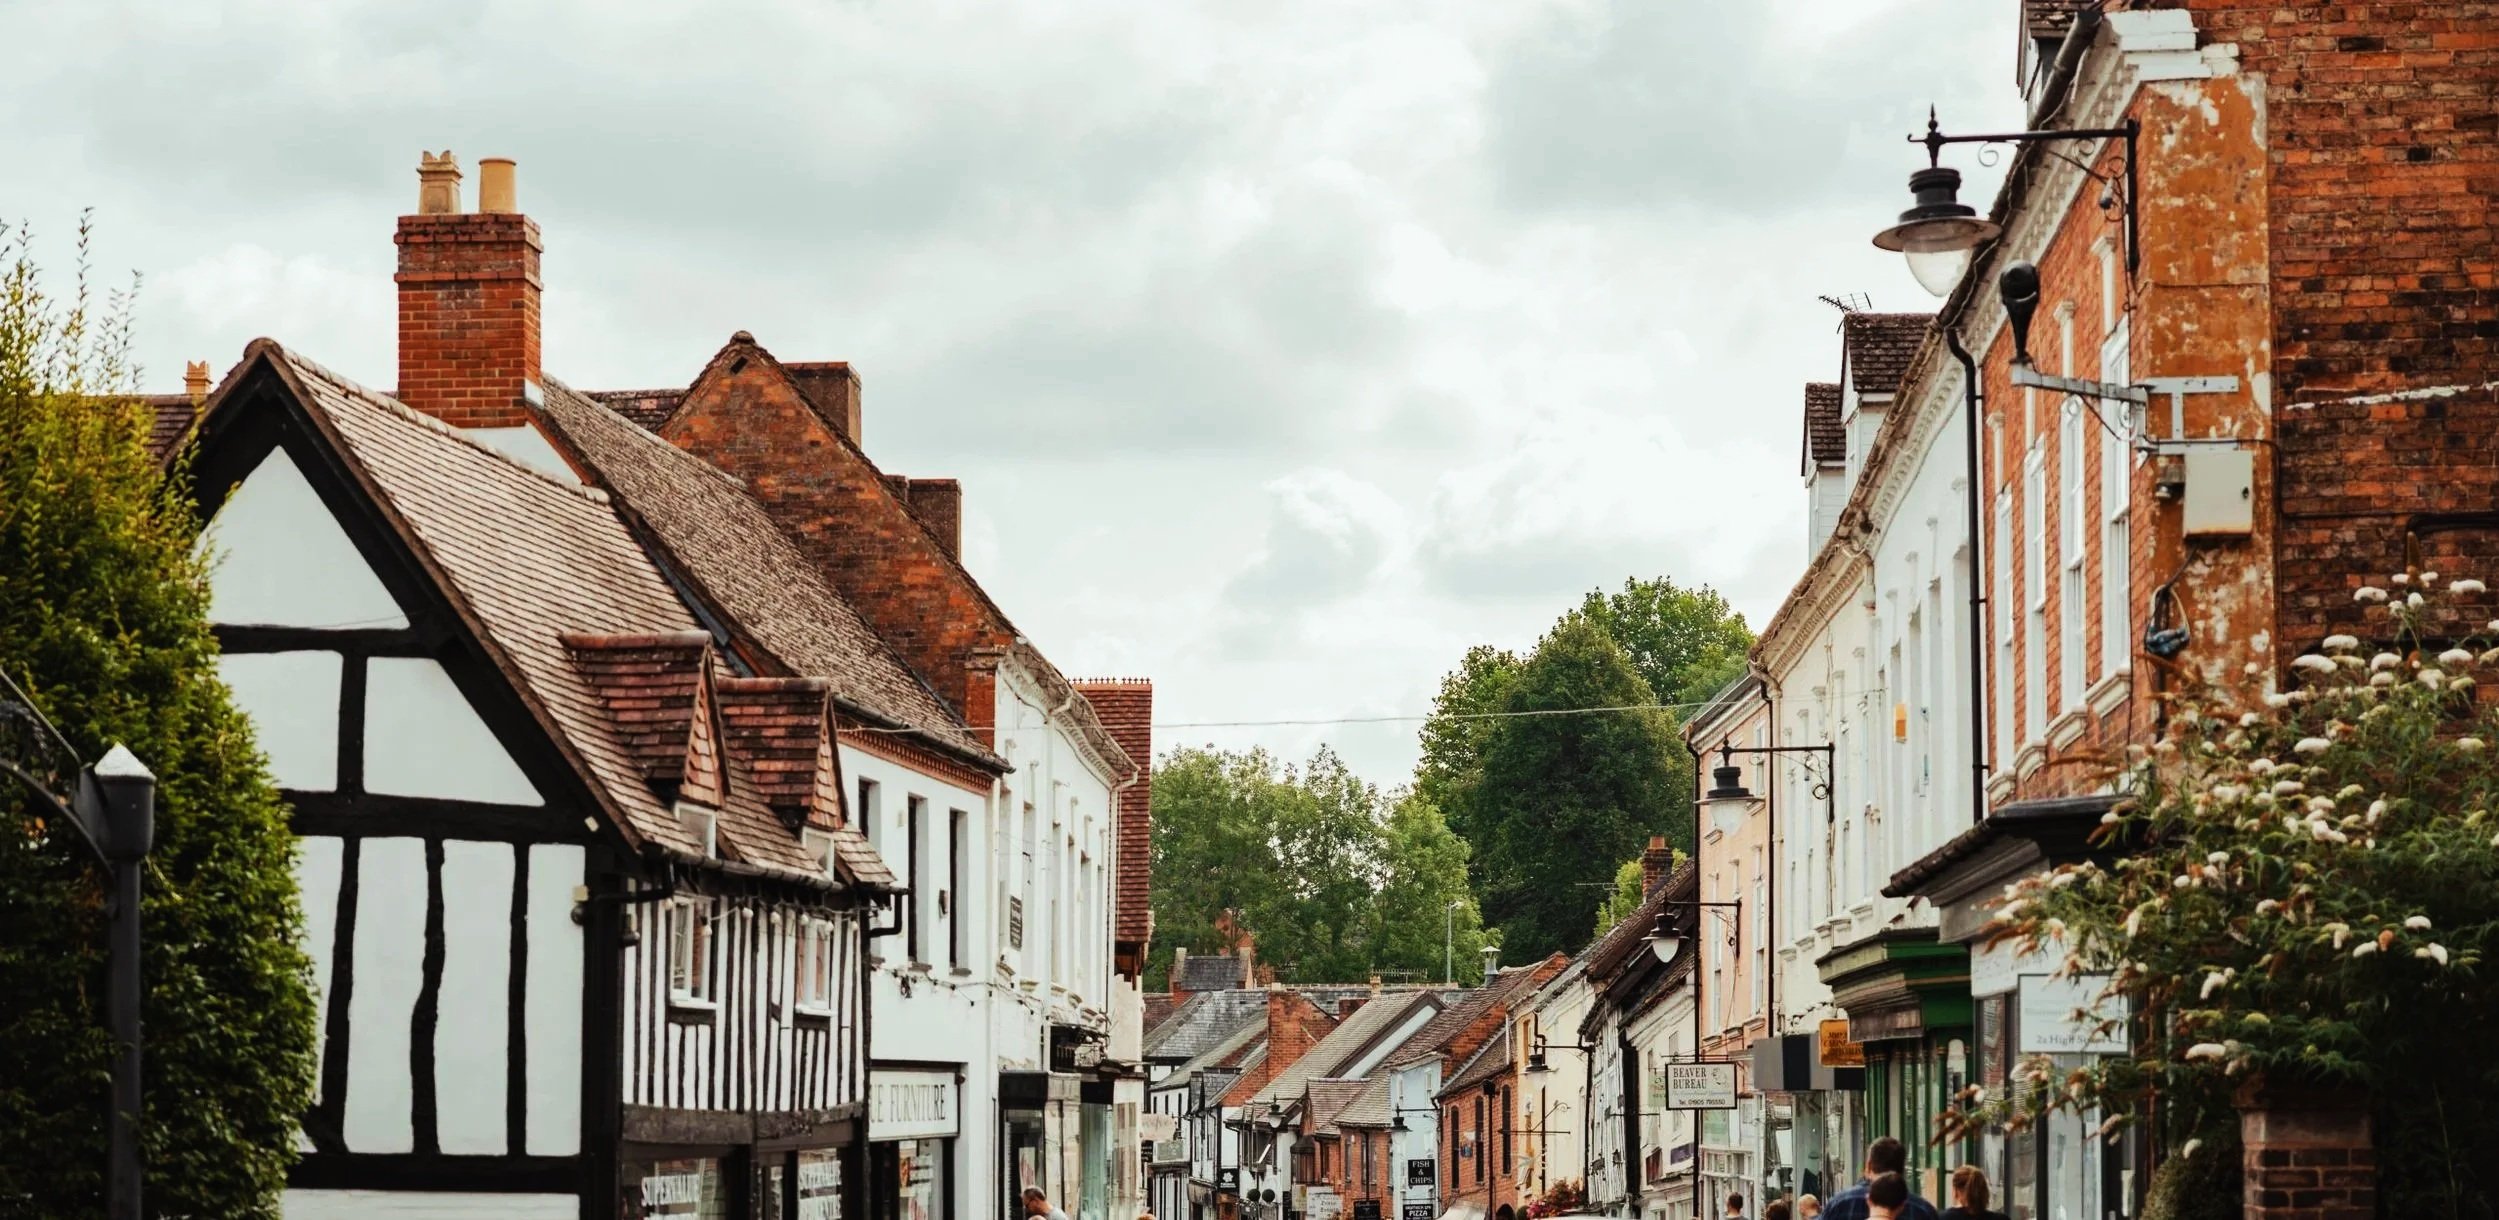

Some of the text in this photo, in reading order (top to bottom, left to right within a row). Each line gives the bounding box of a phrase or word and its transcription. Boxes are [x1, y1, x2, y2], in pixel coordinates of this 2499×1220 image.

[1673, 1067, 1707, 1078] BEAVER
[1673, 1079, 1707, 1089] BUREAU
[890, 1083, 946, 1123] FURNITURE
[1412, 1160, 1430, 1168] FISH
[1418, 1168, 1424, 1176] &
